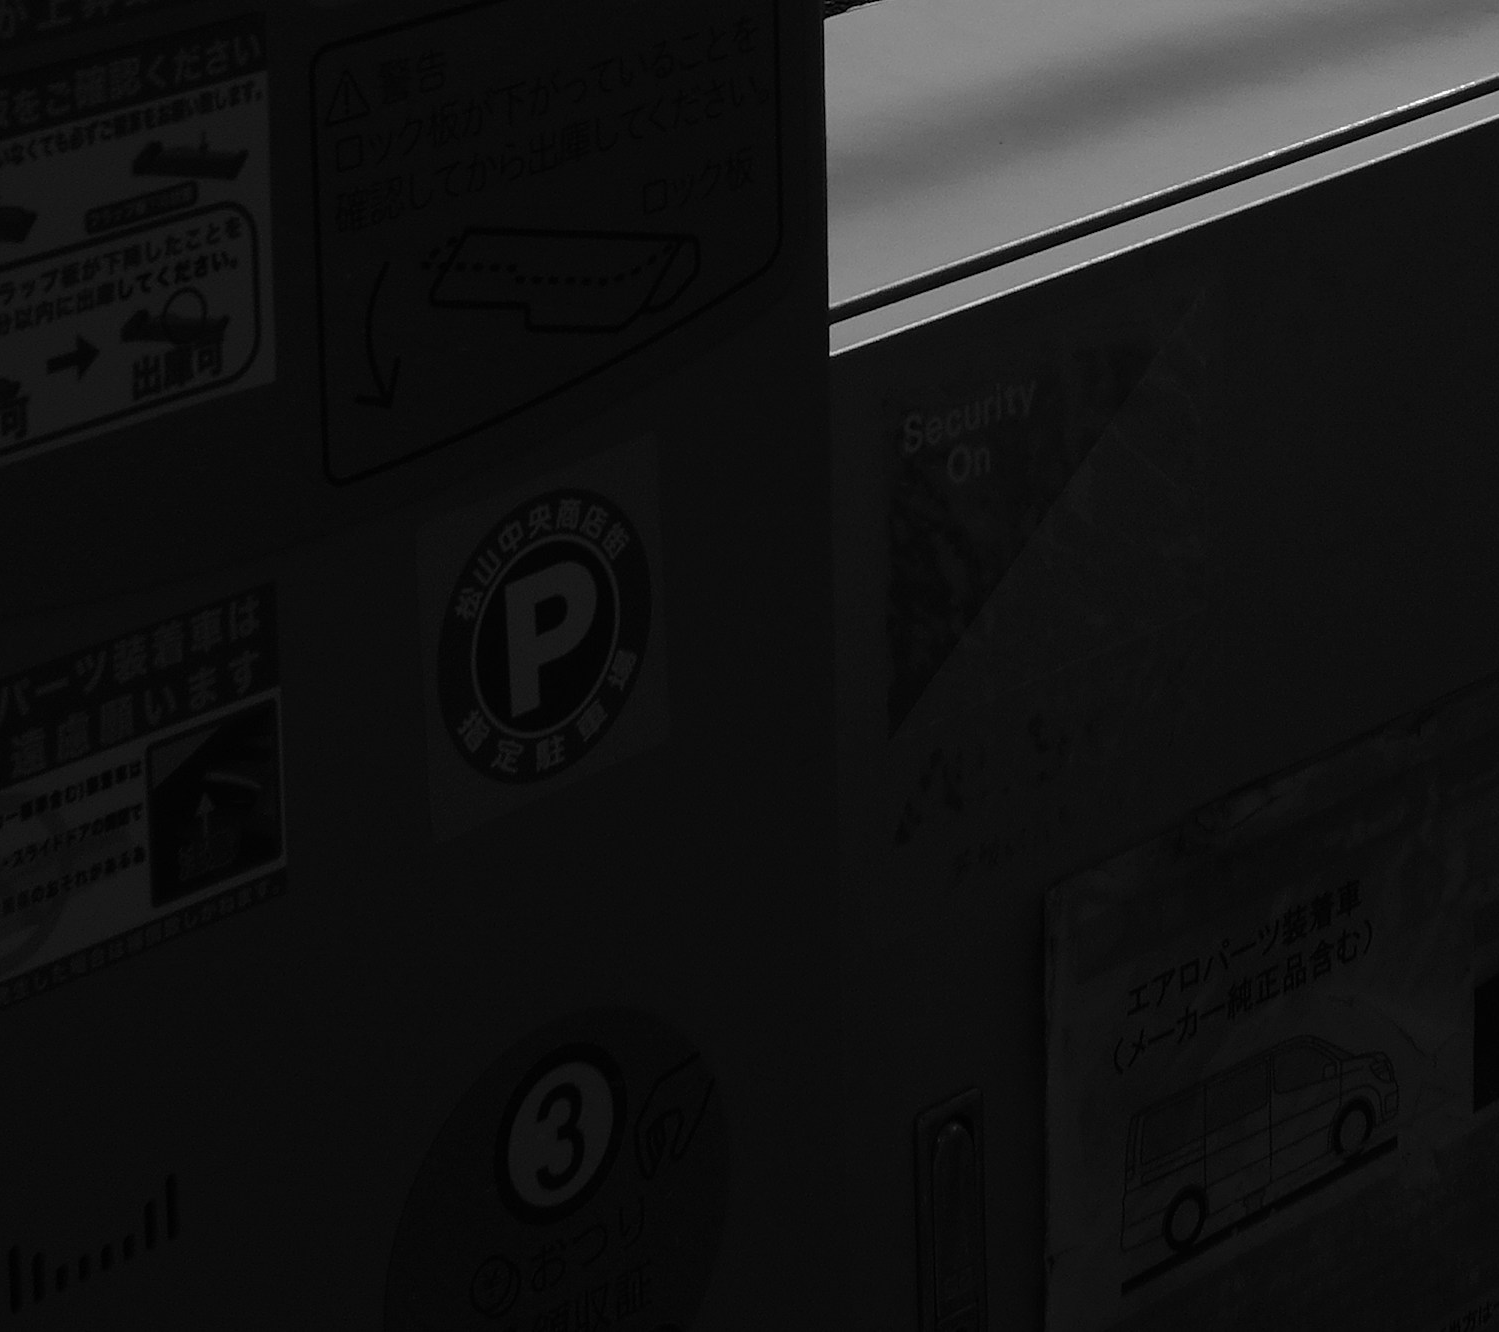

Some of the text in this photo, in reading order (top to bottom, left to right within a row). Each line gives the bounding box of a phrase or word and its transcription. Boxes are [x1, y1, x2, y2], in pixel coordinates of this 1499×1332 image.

[335, 15, 759, 174] ロック板が下がっていることを
[642, 147, 757, 216] ロック板
[902, 379, 1038, 458] Security
[946, 443, 992, 484] On
[504, 559, 598, 719] P
[1126, 879, 1362, 1017] エアロパーツ装着車
[530, 1196, 646, 1293] おつり
